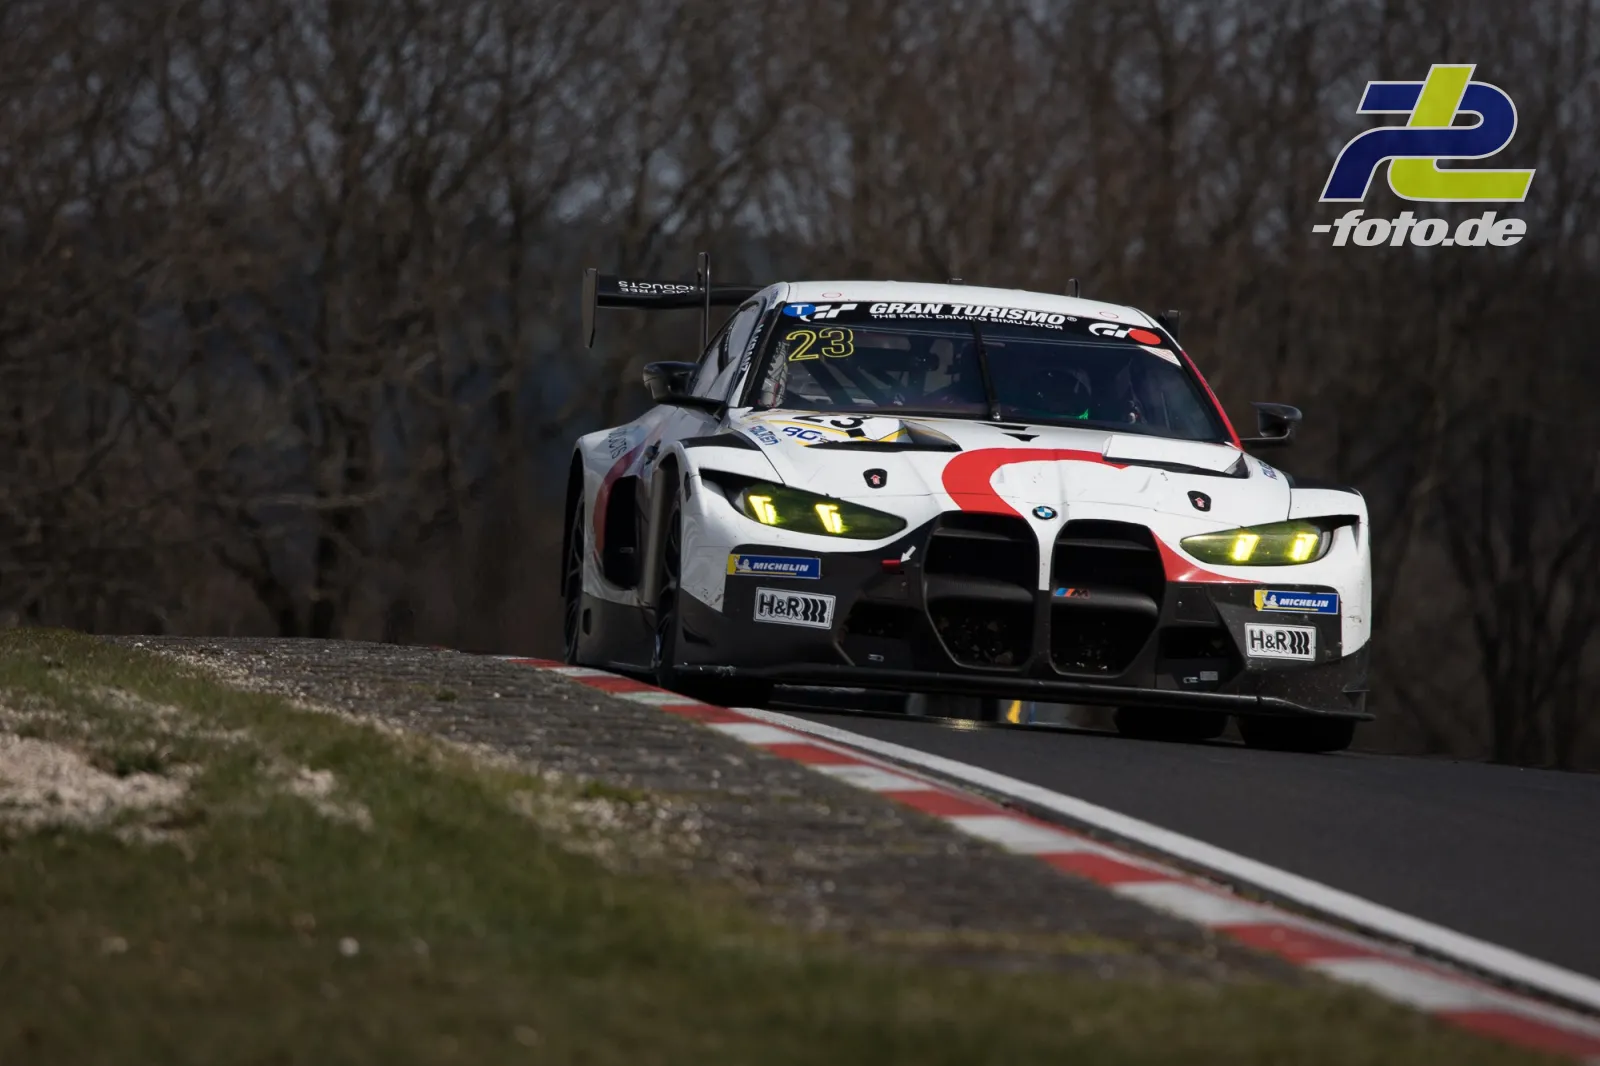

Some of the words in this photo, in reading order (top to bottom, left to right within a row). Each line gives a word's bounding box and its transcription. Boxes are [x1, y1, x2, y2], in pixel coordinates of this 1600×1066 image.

[869, 302, 944, 315] GRAN
[991, 317, 1064, 331] SIMULATOR
[785, 326, 855, 362] 23
[752, 561, 810, 573] MICHELIN
[758, 592, 801, 617] H&R
[1279, 598, 1330, 608] MICHELIN
[1250, 629, 1288, 651] H&R
